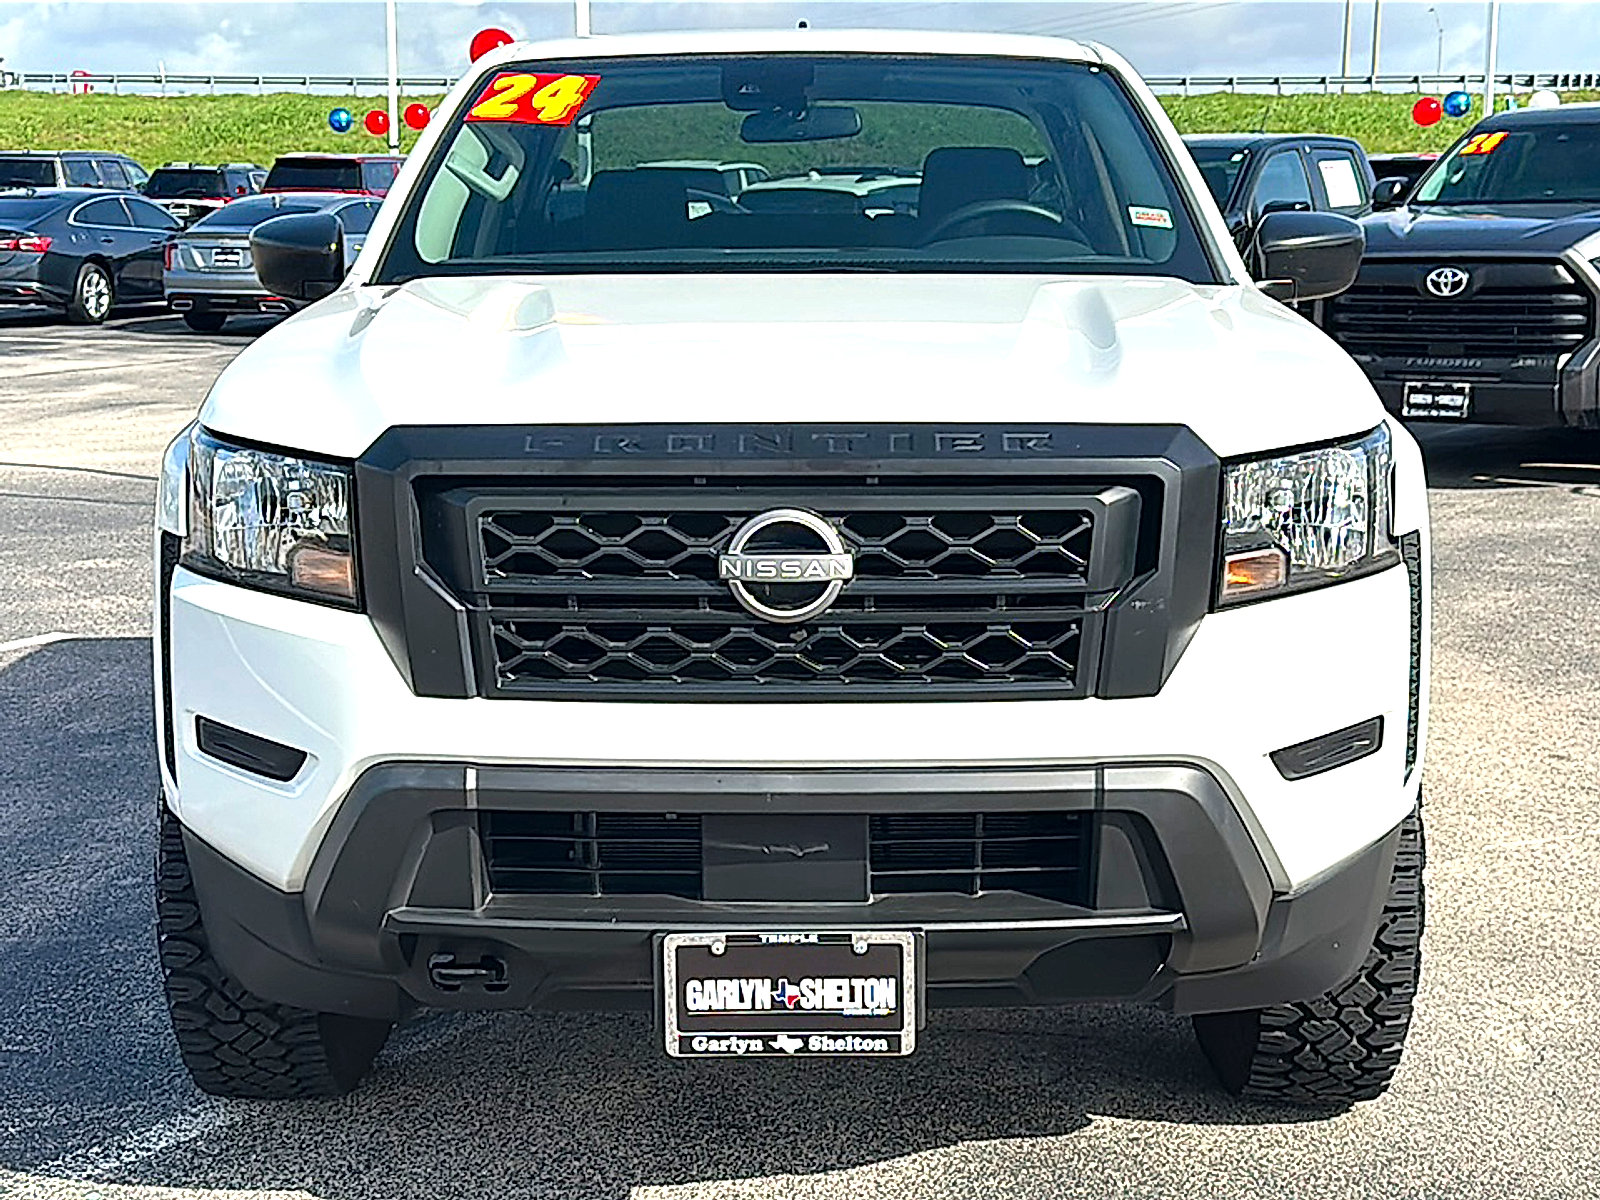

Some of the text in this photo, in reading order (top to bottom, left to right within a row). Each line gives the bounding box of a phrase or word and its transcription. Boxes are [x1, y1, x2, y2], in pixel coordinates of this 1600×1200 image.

[471, 73, 588, 122] 24
[523, 432, 1057, 455] FRONTIER
[720, 559, 851, 578] NISSAN
[759, 933, 820, 944] TEMPLE
[685, 977, 897, 1011] GARLYN SHELTON
[691, 1036, 889, 1055] Garlyn Shelton
